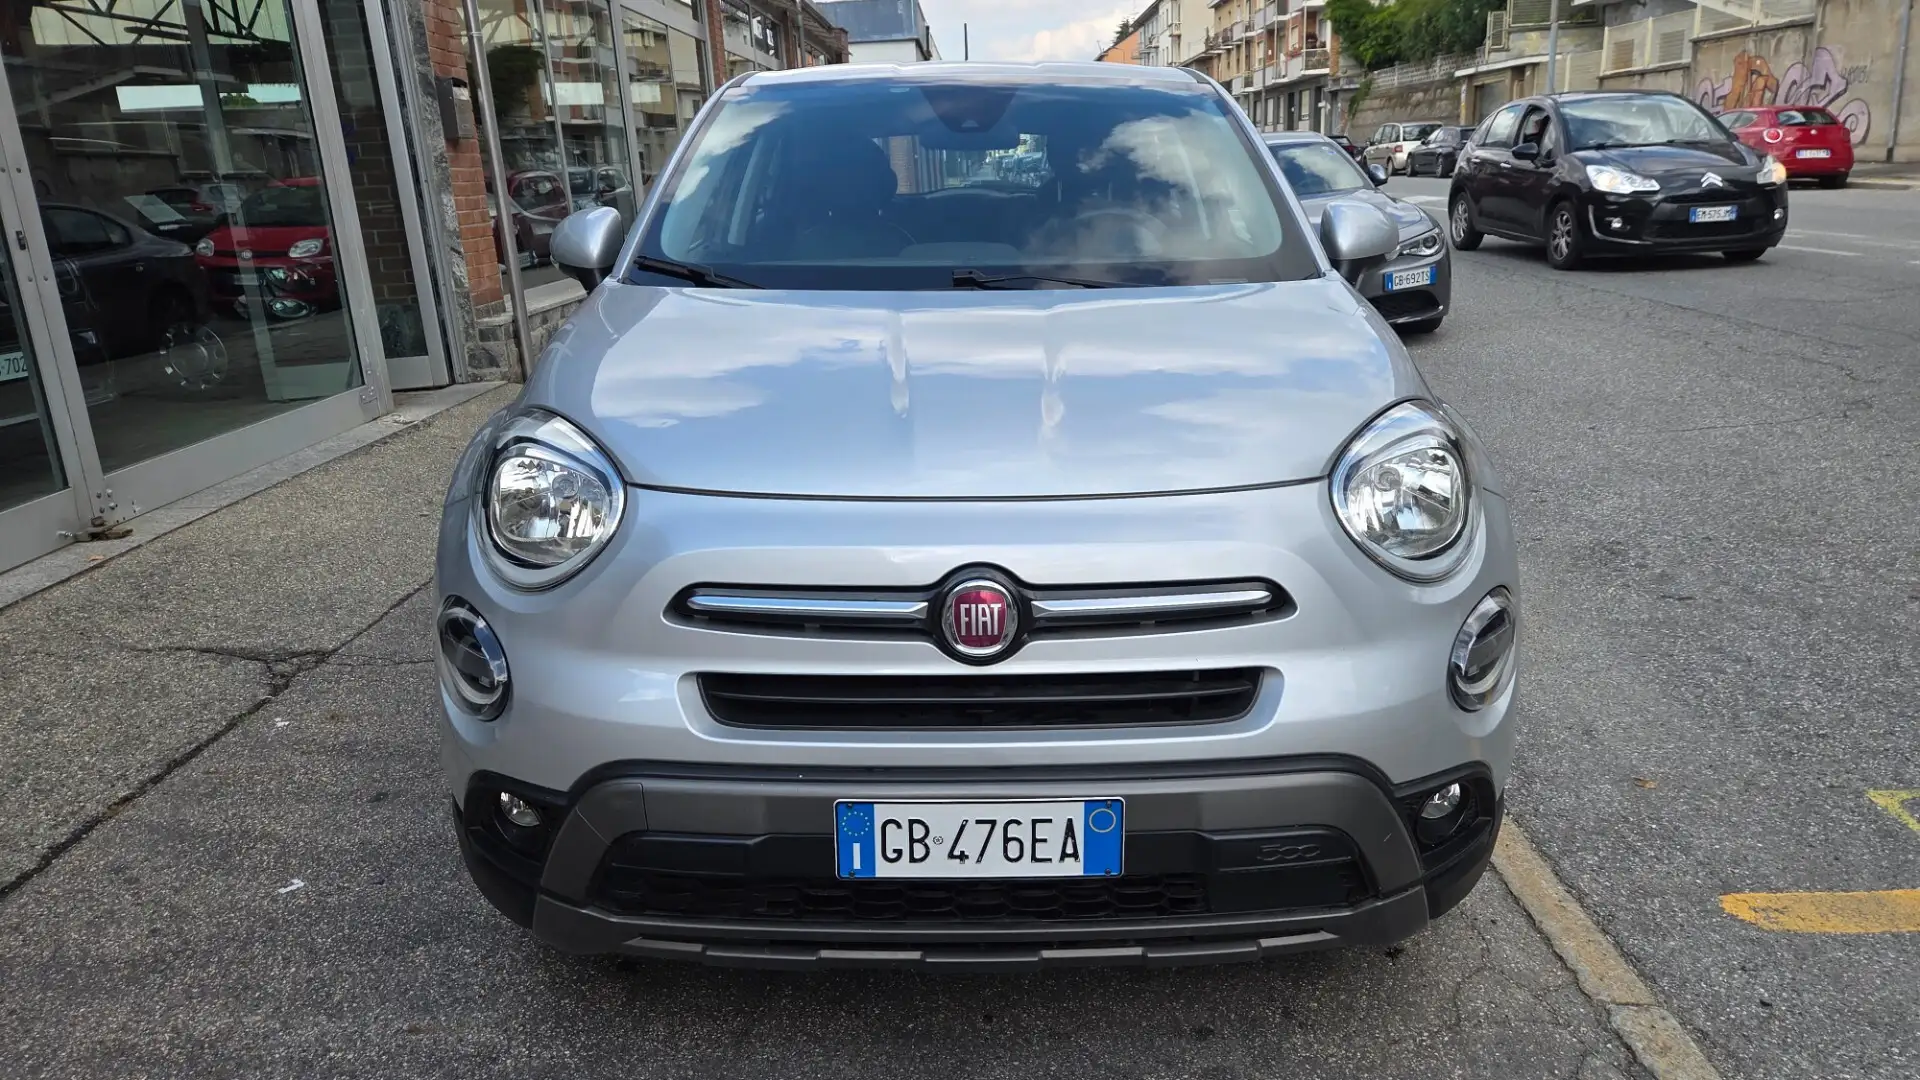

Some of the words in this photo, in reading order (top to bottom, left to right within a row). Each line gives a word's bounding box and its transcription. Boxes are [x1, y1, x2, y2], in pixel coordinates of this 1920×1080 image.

[1394, 275, 1404, 287] GB
[1405, 270, 1430, 285] 692TS
[960, 603, 1002, 636] FIAT
[880, 818, 931, 864] GB
[946, 817, 1081, 864] 476EA
[1256, 844, 1321, 861] 500
